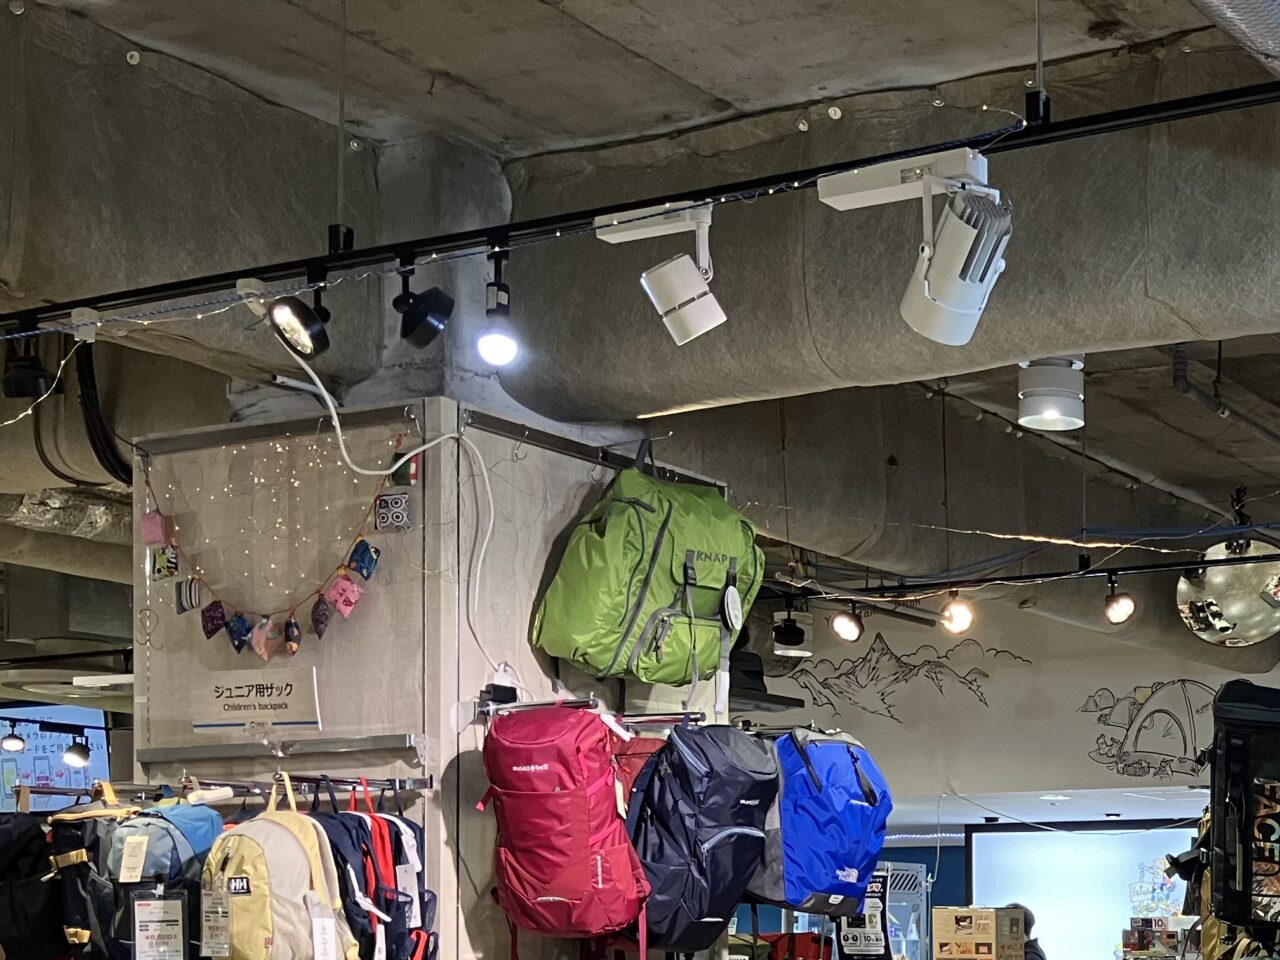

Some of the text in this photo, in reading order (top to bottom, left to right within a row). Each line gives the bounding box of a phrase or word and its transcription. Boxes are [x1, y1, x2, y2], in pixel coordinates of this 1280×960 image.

[214, 682, 293, 699] ジュニア用ザック
[223, 702, 288, 711] Children's backpack
[1252, 776, 1280, 862] FACE
